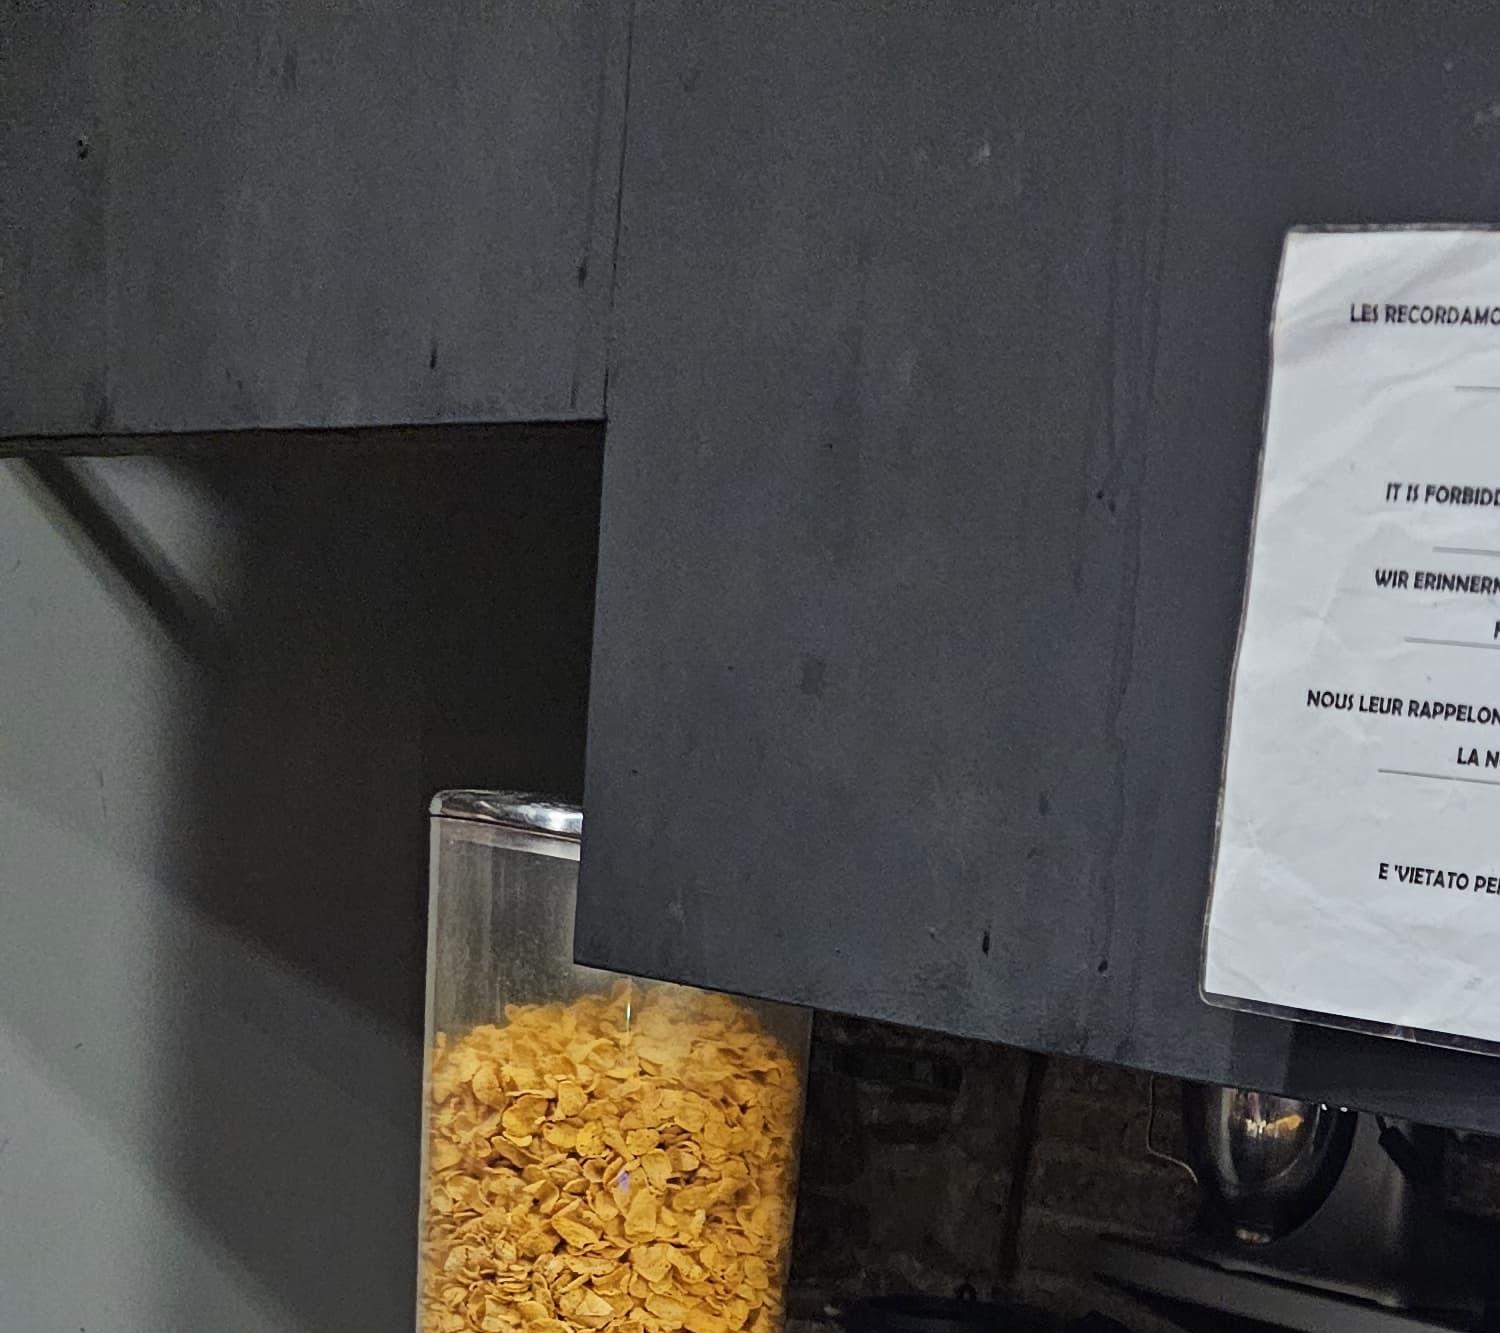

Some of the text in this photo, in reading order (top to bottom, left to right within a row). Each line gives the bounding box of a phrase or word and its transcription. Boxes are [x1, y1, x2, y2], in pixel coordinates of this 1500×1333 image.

[1349, 302, 1380, 325] LES
[1385, 481, 1403, 503] IT
[1405, 483, 1421, 505] IS
[1374, 567, 1410, 591] WIR
[1306, 688, 1355, 713] NOUS
[1358, 693, 1404, 718] LEUR
[1456, 745, 1480, 768] LA
